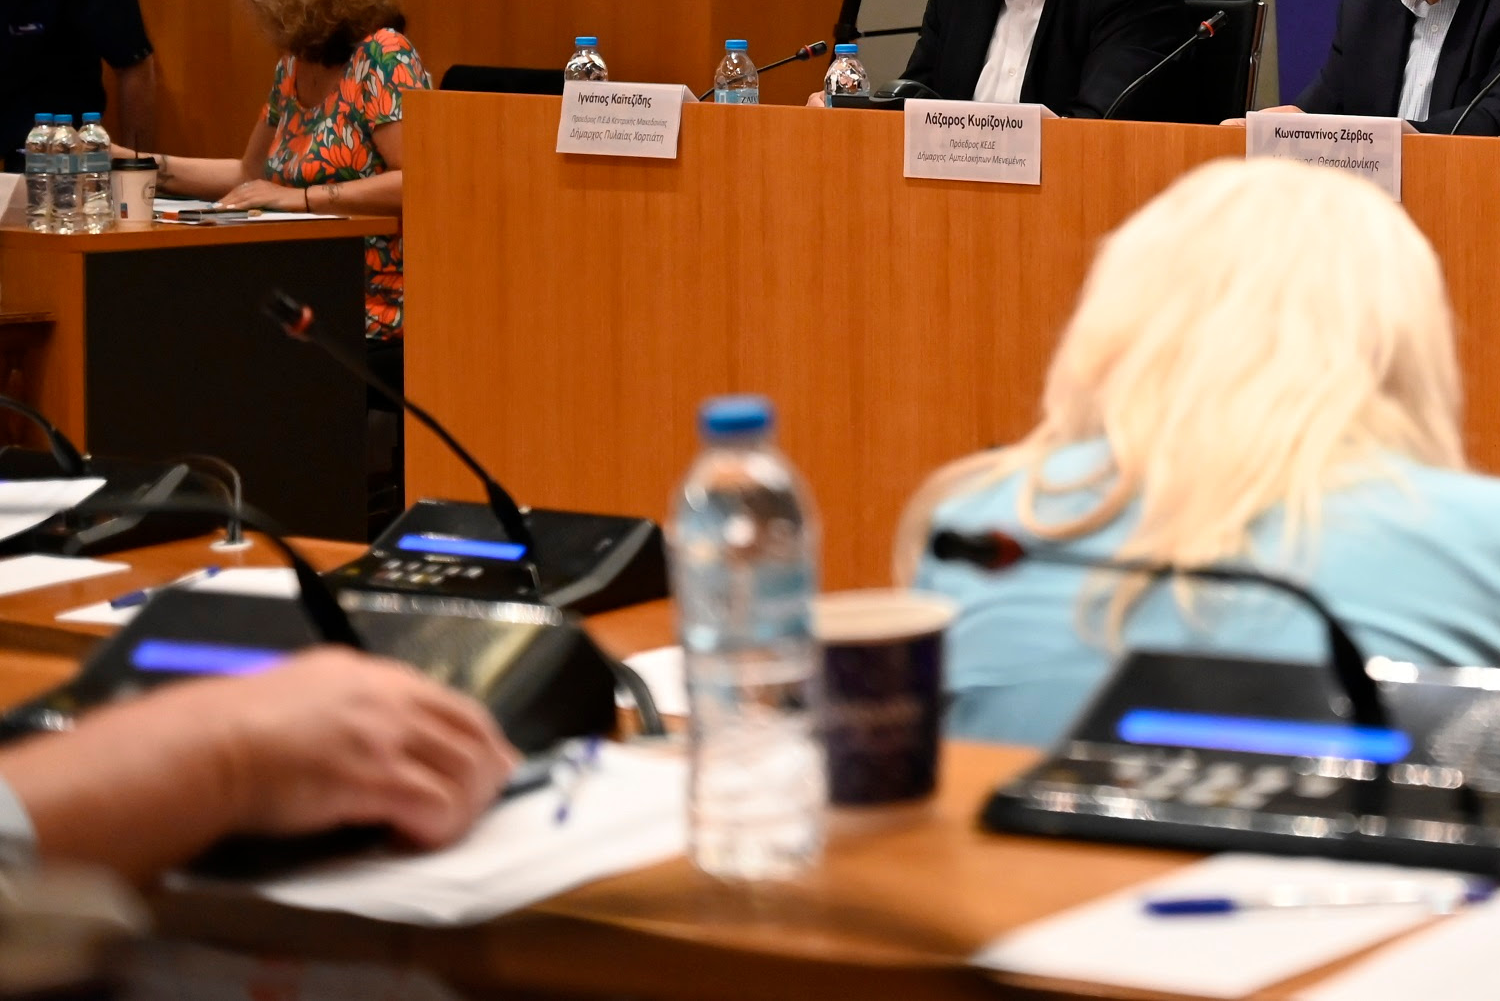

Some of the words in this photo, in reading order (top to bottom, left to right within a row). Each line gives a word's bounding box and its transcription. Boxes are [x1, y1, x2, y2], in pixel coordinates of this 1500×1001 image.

[577, 92, 609, 106] Ιγνάτιος
[611, 93, 652, 108] Καϊτεζίδης
[925, 112, 965, 129] Λάζαρος
[968, 114, 1023, 131] Κυρίζογλου
[570, 128, 603, 141] Δήμαρχος
[604, 130, 632, 142] Πυλαίας
[1274, 127, 1338, 143] Κωνσταντίνος
[1340, 129, 1374, 144] Ζέρβας
[949, 139, 980, 150] Πρόεδρος
[917, 152, 947, 163] Δήμαρχος
[1317, 156, 1380, 171] Θεσσαλονίκης
